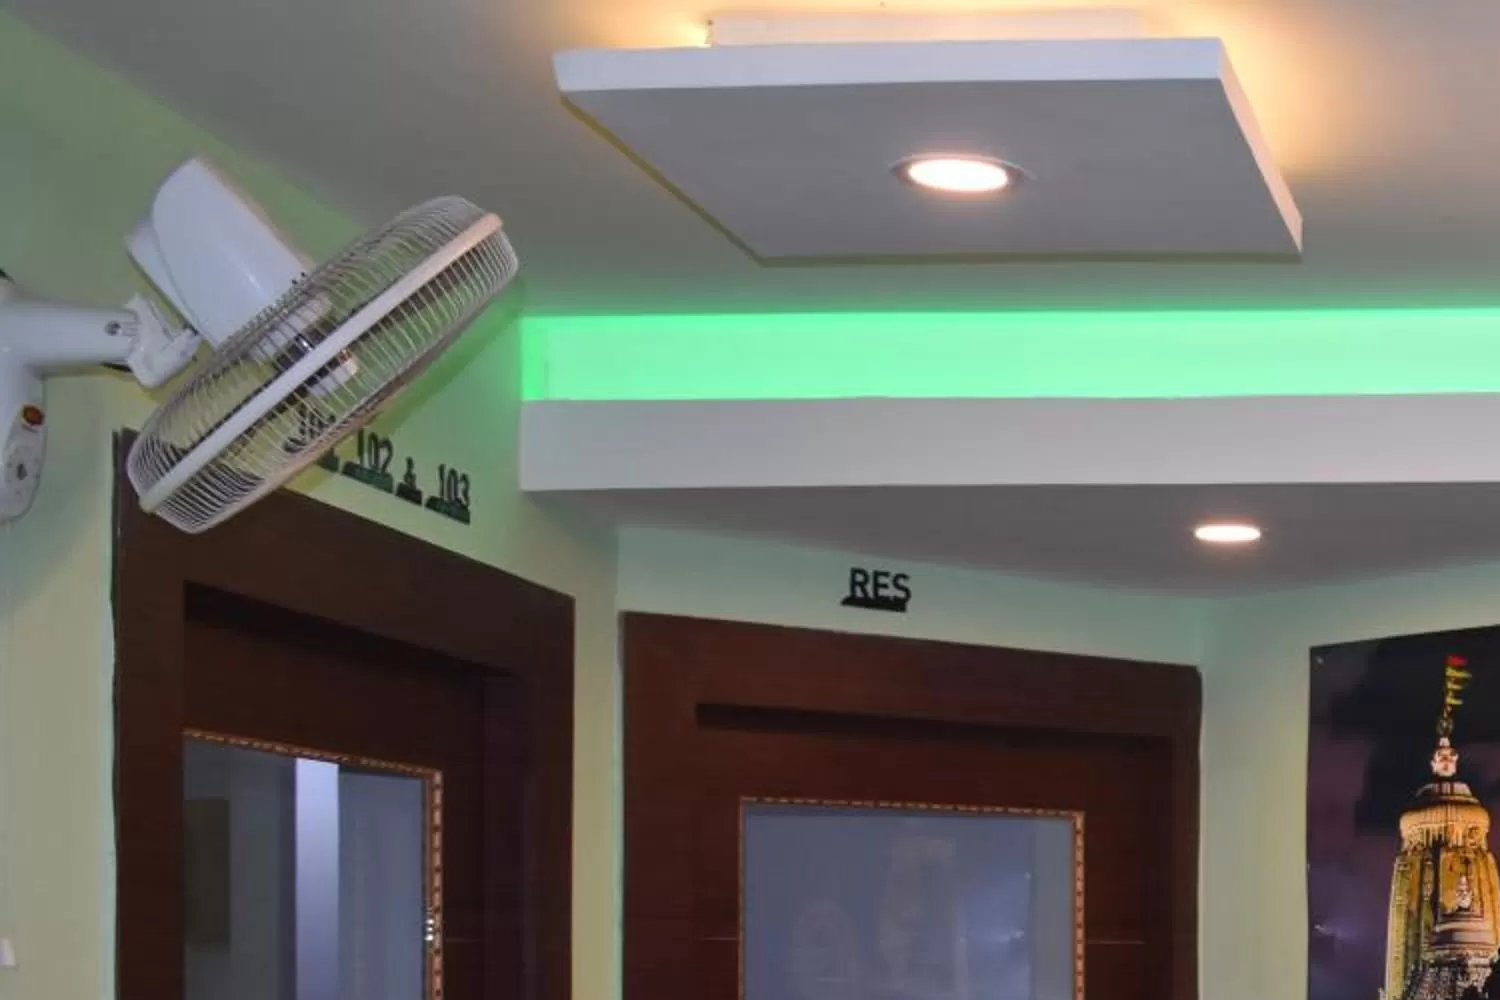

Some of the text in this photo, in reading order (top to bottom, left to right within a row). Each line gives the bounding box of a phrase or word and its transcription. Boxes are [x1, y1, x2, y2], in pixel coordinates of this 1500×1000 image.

[357, 427, 393, 479] 102
[438, 463, 470, 512] 103
[849, 566, 912, 604] RES
